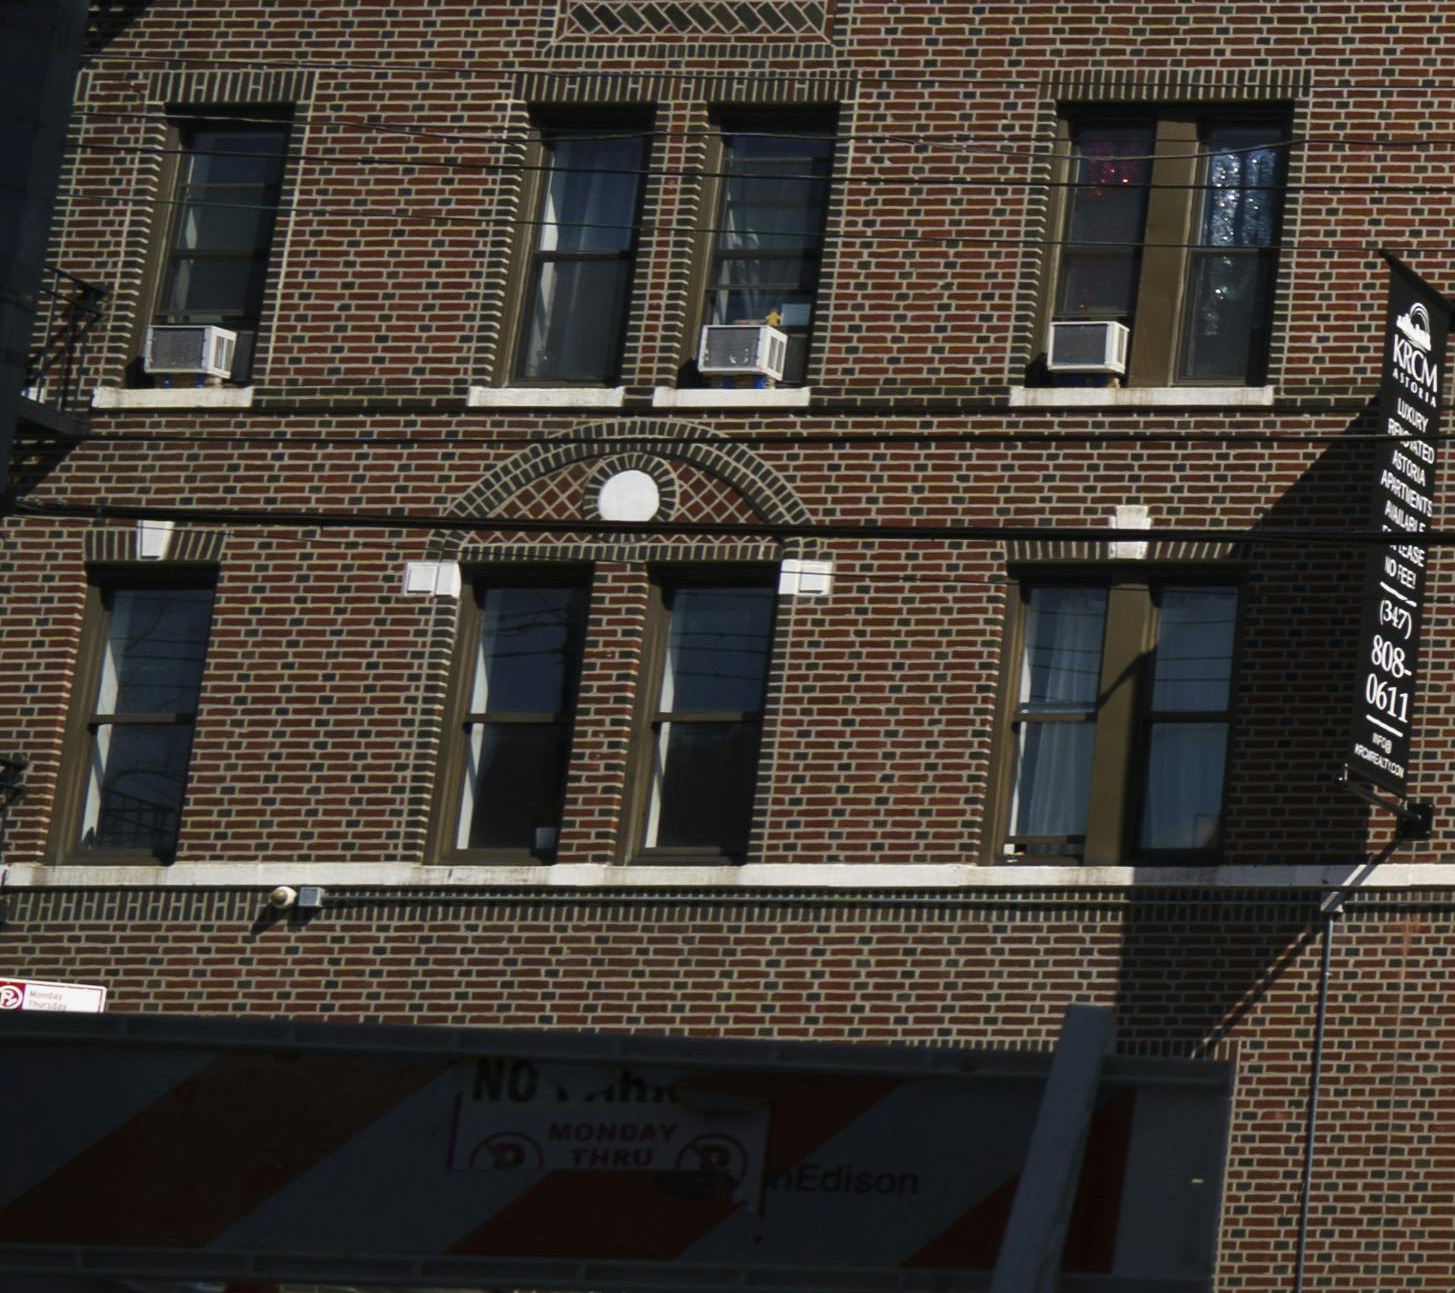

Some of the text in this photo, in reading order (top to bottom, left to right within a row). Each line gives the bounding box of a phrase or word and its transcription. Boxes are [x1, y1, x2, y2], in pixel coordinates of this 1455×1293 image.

[1393, 334, 1438, 393] KRCM
[1392, 368, 1437, 408] ASTORIA
[1397, 397, 1429, 433] LUXURY
[1392, 449, 1426, 487] ASTORIA
[1380, 469, 1433, 518] APARTMENTS
[1384, 556, 1397, 577] NO
[1380, 599, 1412, 640] (347)
[1371, 634, 1412, 678] 808-
[1366, 673, 1408, 723] 0611
[473, 1058, 538, 1103] NO
[548, 1122, 679, 1143] MONDAY
[569, 1149, 655, 1168] THRU
[768, 1164, 920, 1195] nEdison
